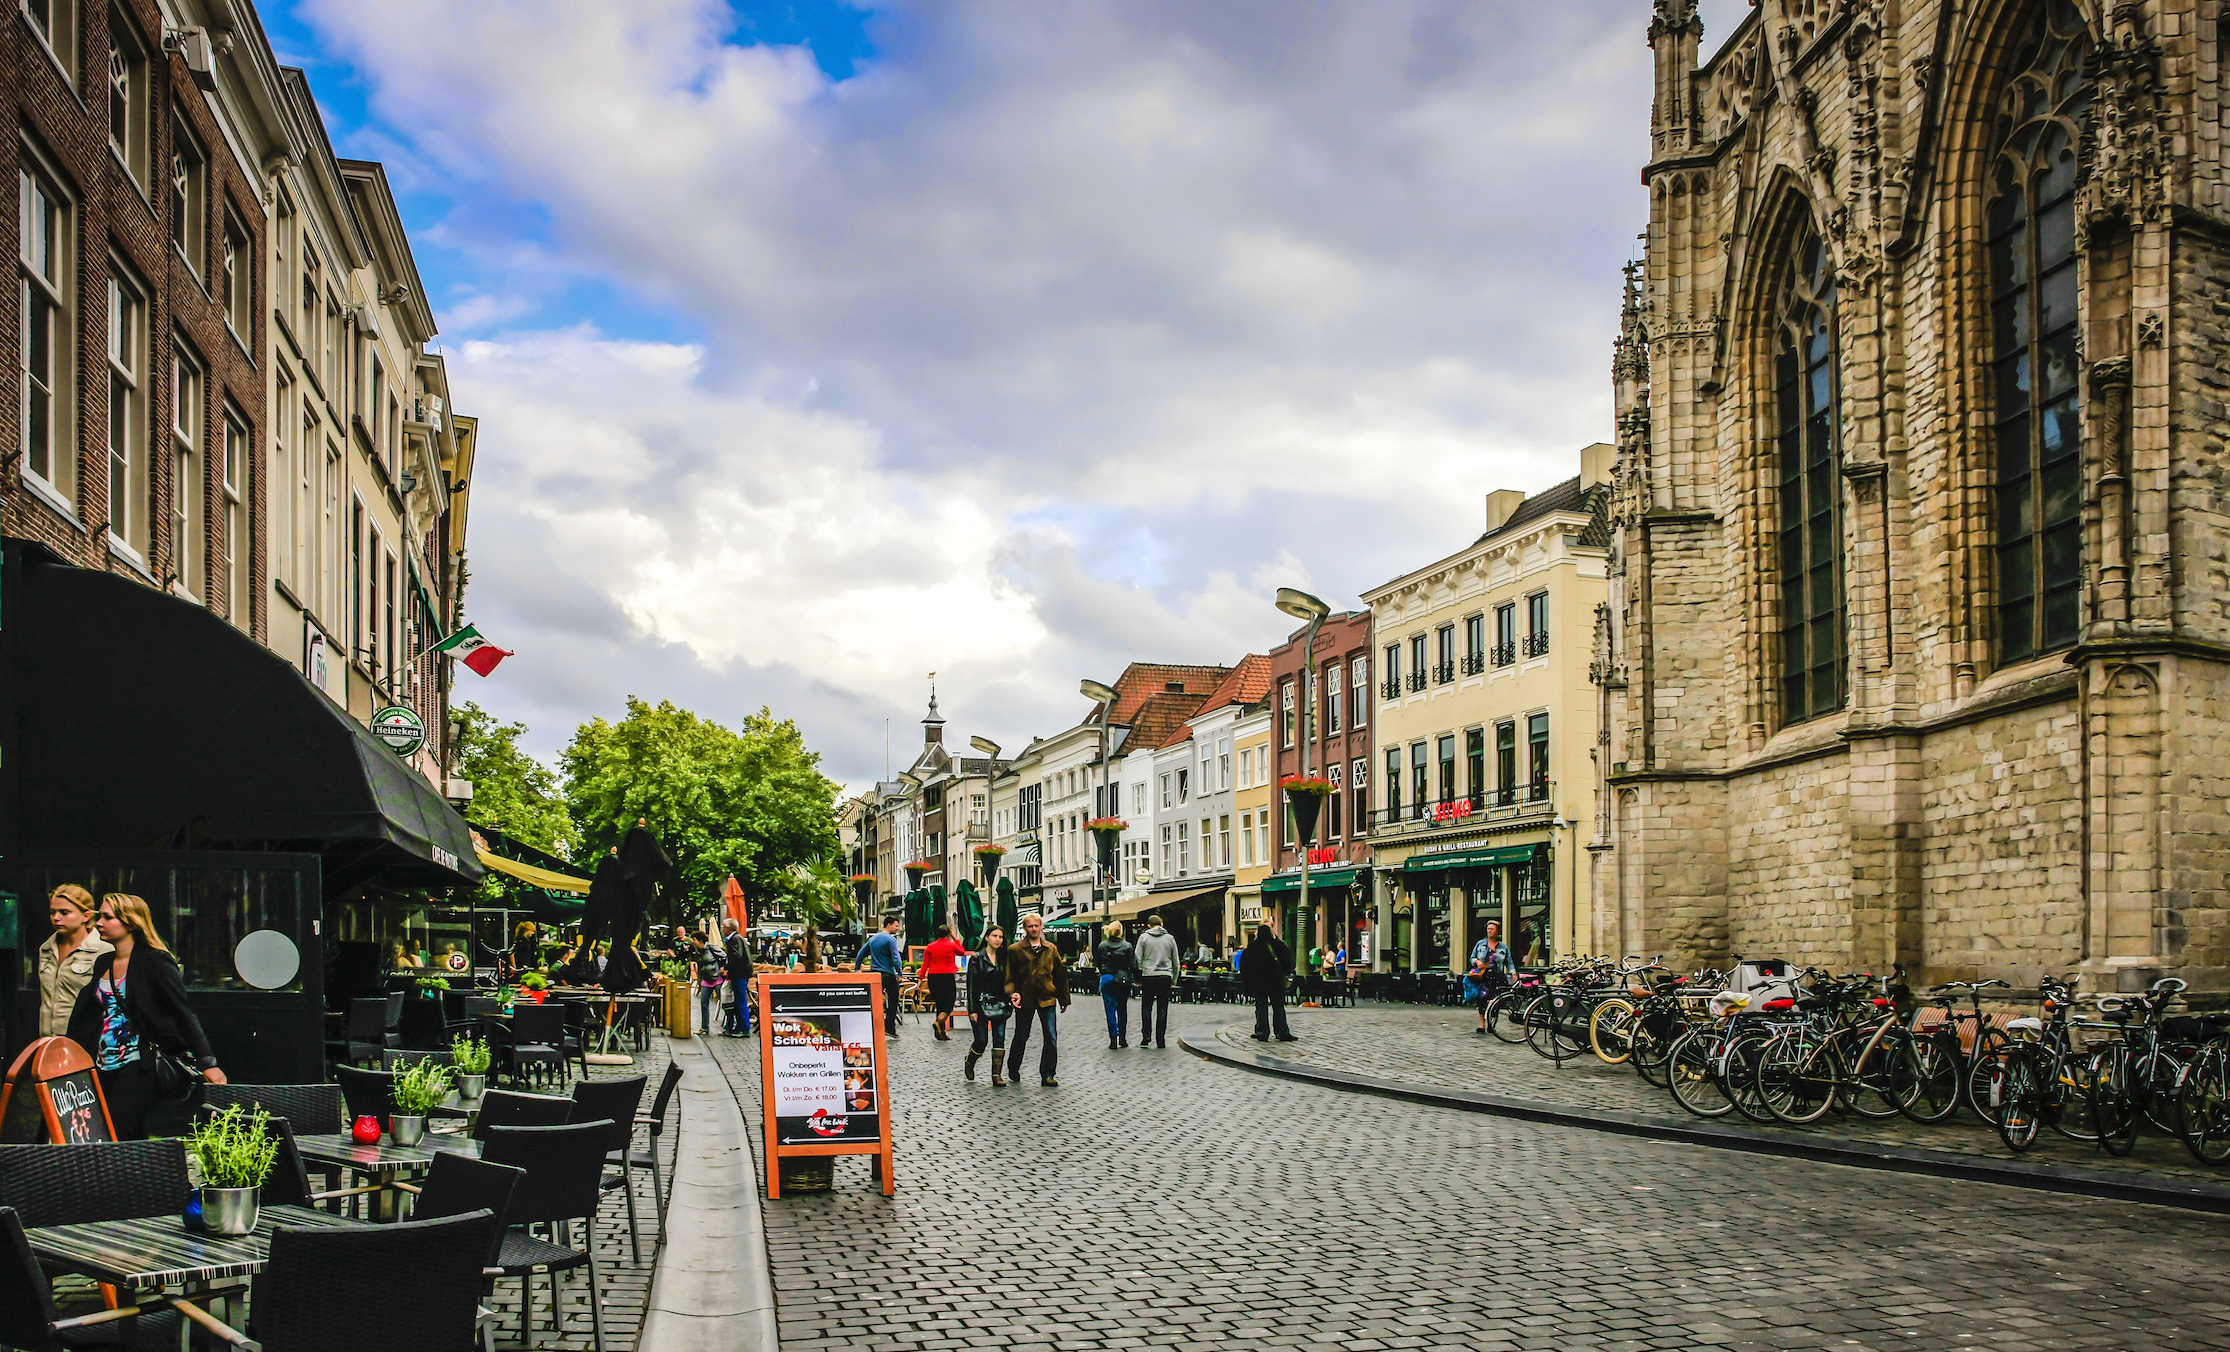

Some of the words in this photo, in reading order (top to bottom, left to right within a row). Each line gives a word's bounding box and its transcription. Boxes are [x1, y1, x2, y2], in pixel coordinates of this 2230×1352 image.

[376, 726, 419, 737] Heineken
[1435, 799, 1472, 822] SUMO
[1424, 845, 1438, 853] SUSHI
[1308, 847, 1335, 865] SUMO
[1241, 907, 1262, 919] BACKX
[772, 1022, 801, 1033] Wok
[773, 1035, 831, 1045] Schotels
